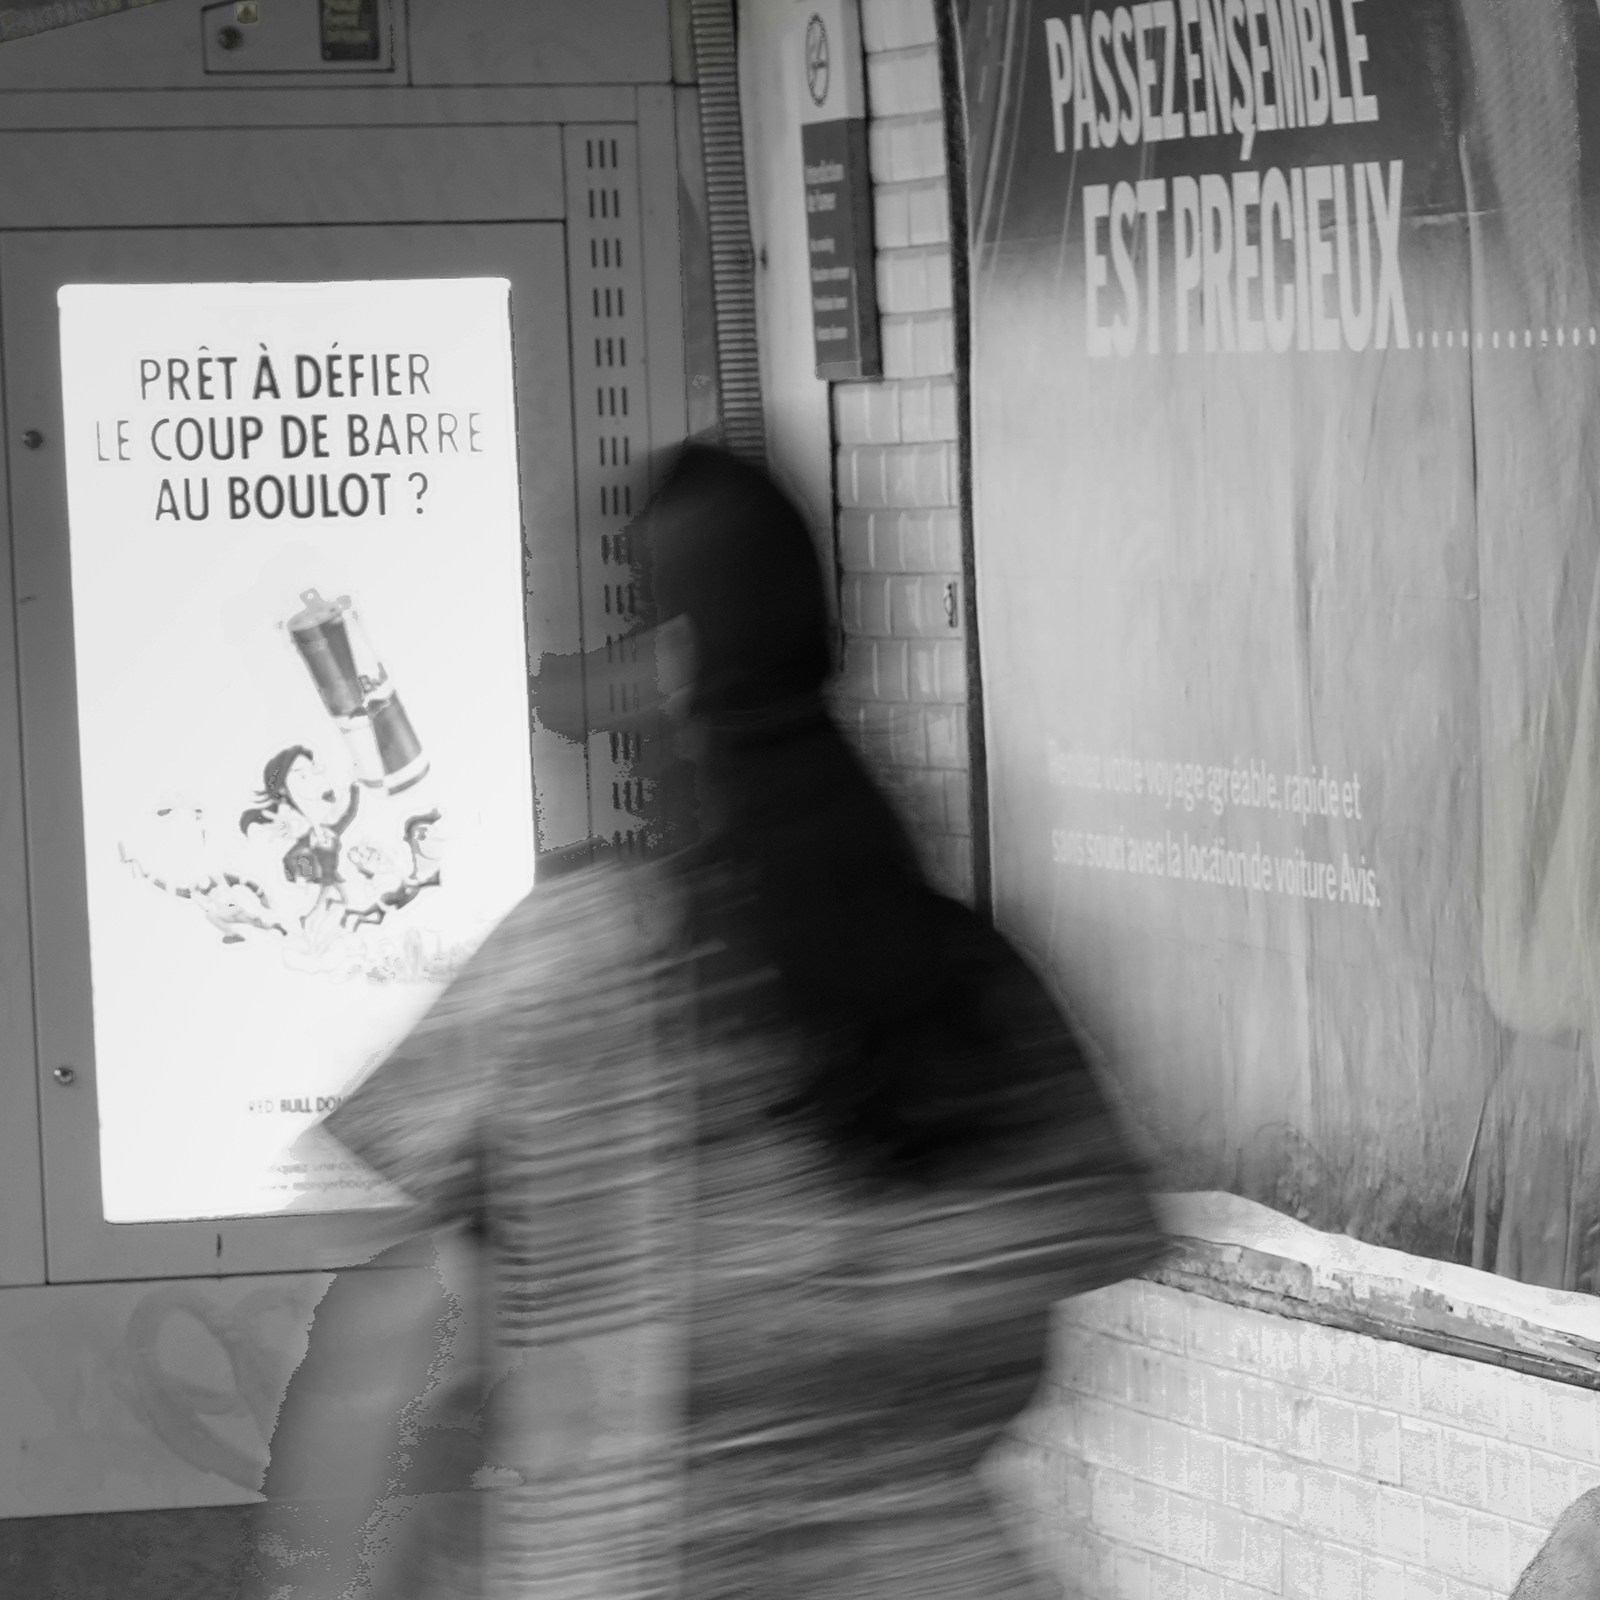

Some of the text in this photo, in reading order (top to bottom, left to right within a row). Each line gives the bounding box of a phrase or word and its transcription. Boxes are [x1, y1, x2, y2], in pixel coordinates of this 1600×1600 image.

[1045, 0, 1185, 153] PASSEZ
[1083, 180, 1167, 357] EST
[140, 342, 431, 401] PRÊT À DÉFIER
[96, 412, 484, 462] LE COUP DE BARRE
[155, 477, 210, 522] AU
[228, 472, 391, 520] BOULOT
[1146, 761, 1205, 813] voyage
[1284, 764, 1339, 827] rapide
[1342, 771, 1363, 821] et
[1127, 837, 1164, 876] avec
[1166, 829, 1181, 878] la
[1183, 830, 1247, 887] location
[1251, 840, 1272, 892] de
[1274, 846, 1337, 902] voiture
